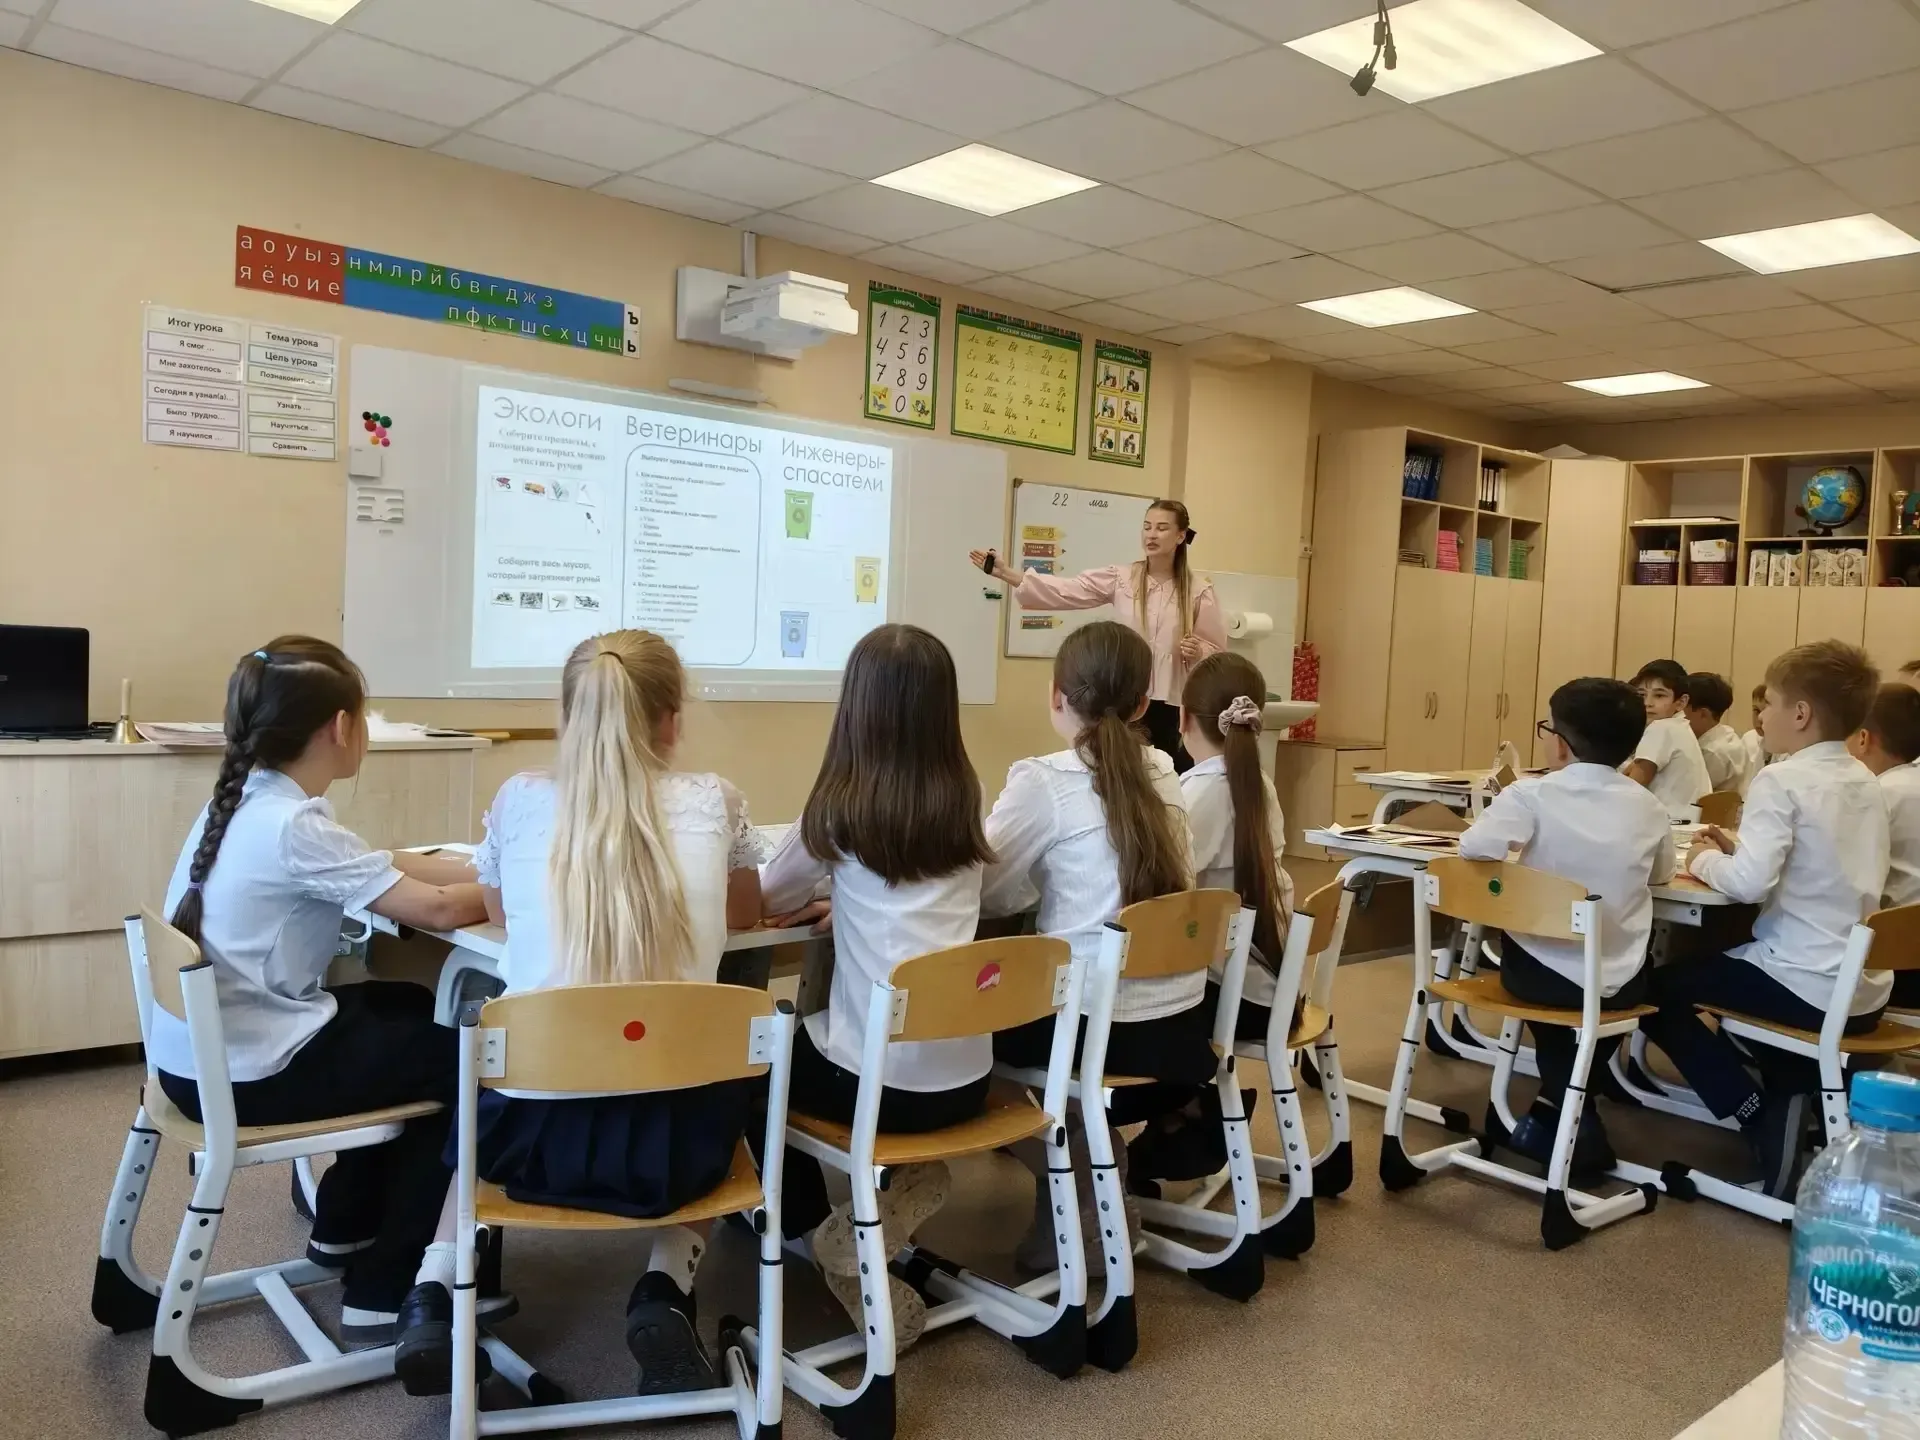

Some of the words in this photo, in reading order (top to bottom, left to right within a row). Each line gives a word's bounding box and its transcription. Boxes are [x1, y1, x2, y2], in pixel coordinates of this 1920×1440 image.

[241, 235, 252, 250] а
[263, 240, 275, 253] о
[286, 243, 297, 261] у
[305, 248, 321, 262] ы
[330, 252, 340, 265] э
[350, 256, 361, 270] н
[369, 260, 382, 274] м
[390, 265, 401, 278] л
[412, 269, 422, 285] р
[431, 268, 442, 286] й
[450, 273, 460, 290] б
[471, 281, 480, 293] в
[491, 285, 498, 296] г
[506, 288, 518, 304] д
[523, 291, 536, 304] ж
[544, 296, 553, 308] з
[240, 266, 251, 279] я
[262, 264, 274, 283] ё
[283, 273, 299, 288] ю
[308, 278, 319, 292] и
[329, 282, 340, 295] е
[894, 299, 914, 308] ЦИФРЫ
[167, 317, 191, 328] Итог
[194, 321, 223, 333] урока
[449, 306, 459, 320] п
[466, 306, 480, 327] ф
[488, 314, 497, 327] к
[506, 317, 515, 330] т
[521, 320, 536, 334] ш
[542, 324, 551, 336] с
[561, 327, 569, 340] х
[577, 330, 587, 346] ц
[595, 334, 603, 346] ч
[608, 336, 622, 352] щ
[880, 310, 887, 327] 1
[899, 315, 909, 334] 2
[920, 321, 929, 338] 3
[186, 342, 204, 350] смог
[266, 332, 290, 343] Тема
[292, 336, 318, 348] урока
[876, 337, 888, 355] 4
[897, 342, 908, 359] 5
[918, 347, 928, 364] 6
[160, 359, 176, 367] Мне
[178, 362, 221, 373] захотелось
[265, 352, 289, 363] Цель
[291, 356, 317, 367] урока
[876, 363, 886, 381] 7
[897, 368, 906, 386] 8
[917, 373, 927, 390] 9
[154, 386, 187, 397] Сегодня
[277, 401, 302, 410] Узнать
[896, 395, 905, 412] 0
[166, 408, 187, 416] Было
[494, 397, 601, 431] Экологи
[176, 431, 212, 441] научился
[499, 428, 543, 441] Соберите
[626, 416, 762, 455] Ветеринары
[273, 442, 307, 452] Сравнить
[489, 441, 534, 452] помощью
[537, 447, 574, 457] которых
[577, 453, 605, 461] можно
[782, 438, 886, 471] Инженеры-
[513, 457, 555, 467] очистить
[784, 466, 883, 491] спасатели
[1089, 499, 1108, 508] мая
[498, 557, 539, 567] Соберите
[542, 560, 560, 568] весь
[563, 562, 592, 570] мусор,
[487, 572, 525, 580] который
